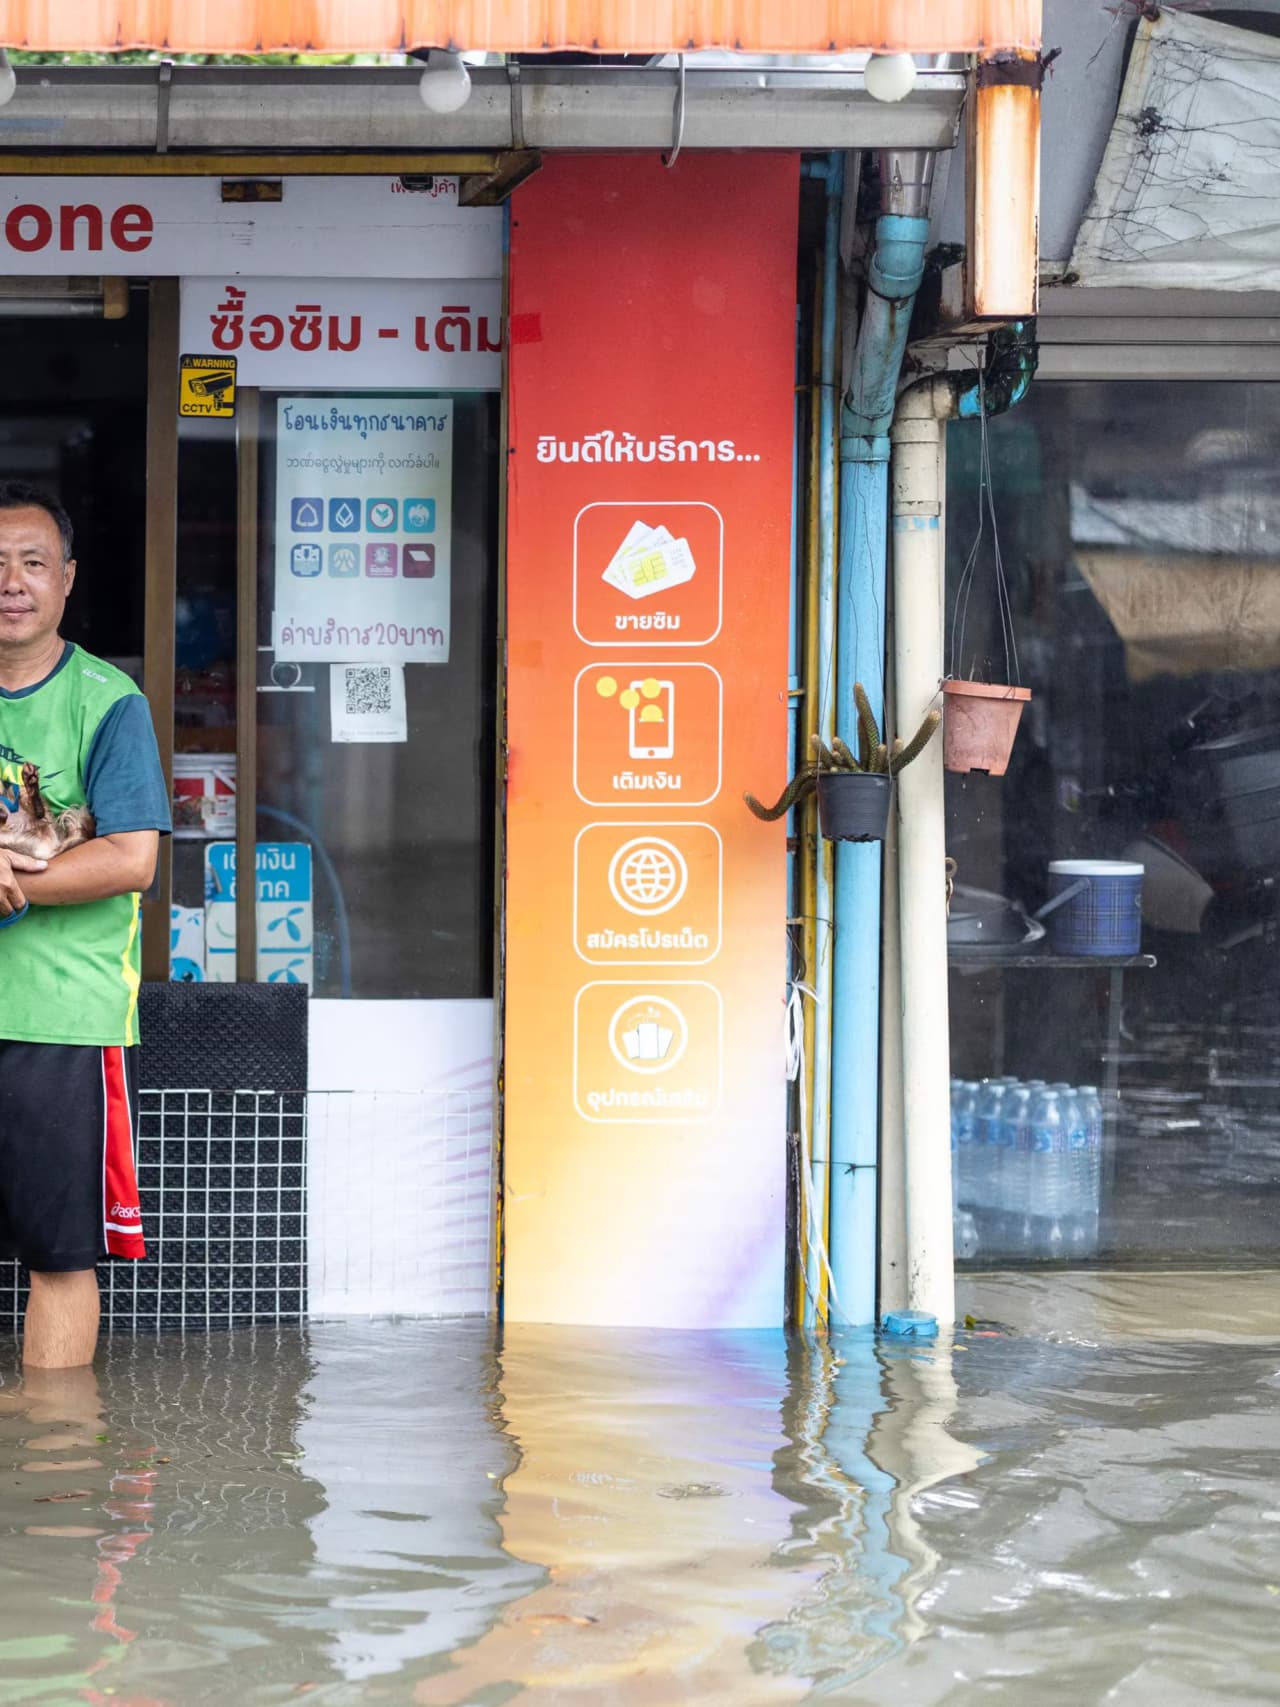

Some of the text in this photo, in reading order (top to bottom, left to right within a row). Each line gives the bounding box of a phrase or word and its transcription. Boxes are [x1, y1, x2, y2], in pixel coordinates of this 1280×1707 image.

[209, 285, 503, 352] ซื้อซิม - เติม
[192, 358, 236, 369] WARNING
[182, 403, 212, 413] CCTV
[283, 405, 448, 440] โอนเงินทุกธนาคาร
[536, 430, 761, 463] ยินดีให้บริการ...
[281, 617, 444, 646] ค่าบริการ20บาท
[615, 611, 681, 630] ขายซิม
[612, 771, 682, 790] เติมเงิน
[586, 927, 709, 949] สมัครโปรเน็ต
